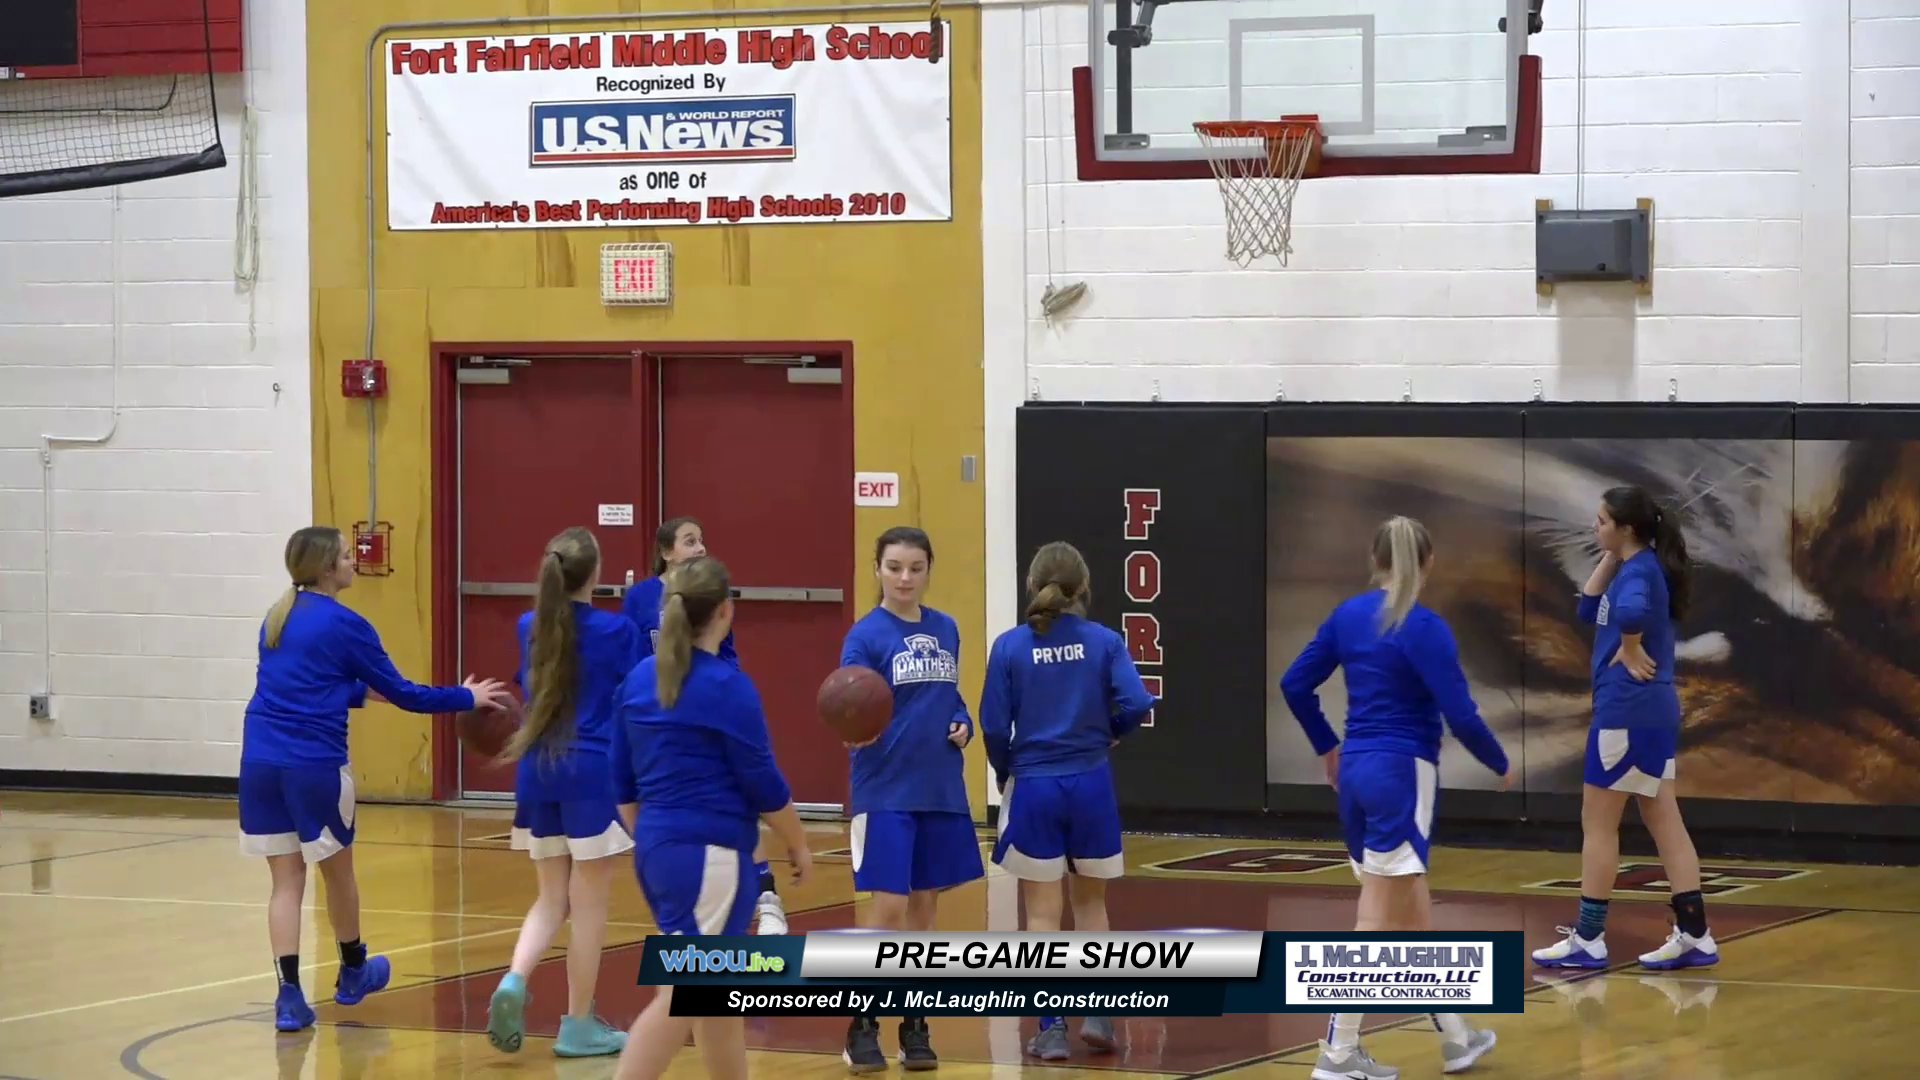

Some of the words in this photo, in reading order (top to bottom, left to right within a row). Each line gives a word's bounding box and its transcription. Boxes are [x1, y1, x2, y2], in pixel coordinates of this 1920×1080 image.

[391, 42, 457, 75] Fort
[466, 36, 601, 73] Fairfield
[612, 32, 727, 68] Middle
[737, 28, 815, 70] High
[596, 74, 695, 95] Recognized
[704, 73, 726, 92] By
[679, 110, 729, 121] WORLD
[731, 109, 785, 119] REPORT
[619, 174, 638, 190] as
[646, 171, 680, 189] one
[689, 171, 707, 189] of
[431, 201, 530, 223] America's
[534, 199, 582, 221] Best
[587, 197, 701, 223] Performing
[706, 196, 755, 222] High
[760, 194, 844, 217] Schools
[849, 192, 906, 216] 2010
[614, 258, 655, 293] EXIT
[858, 481, 894, 499] EXIT
[1032, 643, 1085, 665] PRYOR
